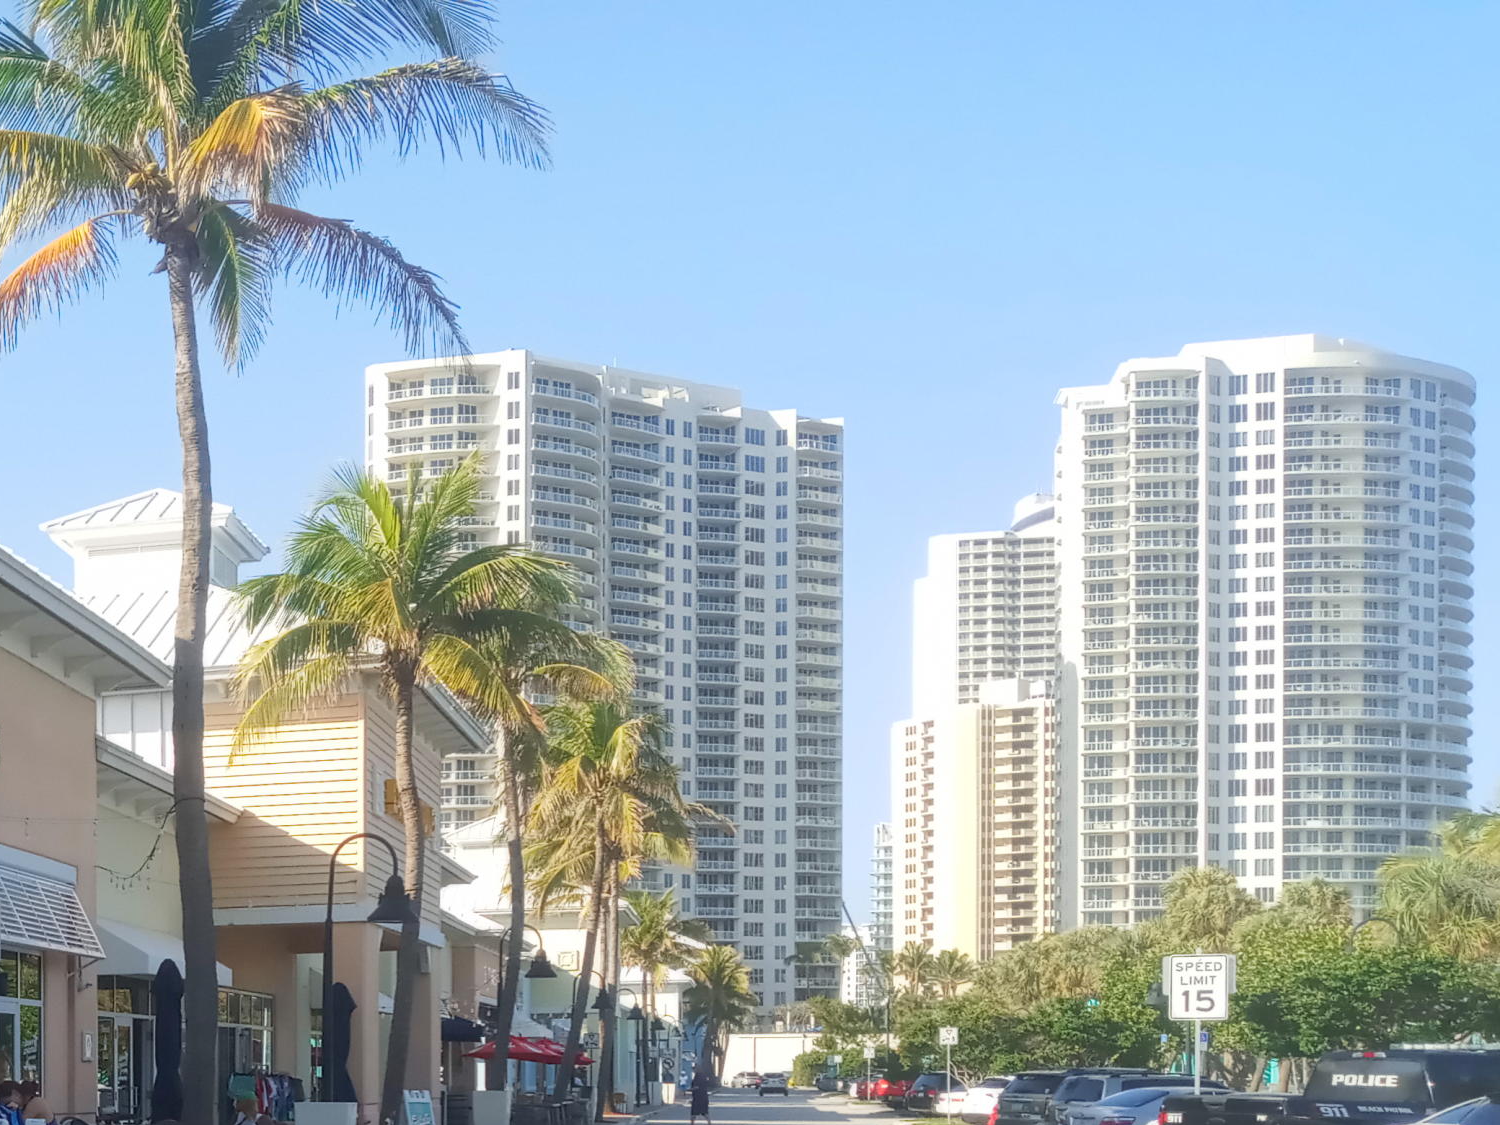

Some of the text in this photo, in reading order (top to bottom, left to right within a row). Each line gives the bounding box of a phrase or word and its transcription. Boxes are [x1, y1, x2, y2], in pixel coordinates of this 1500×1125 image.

[1175, 961, 1222, 972] SPEED
[1180, 975, 1217, 986] LIMIT
[1181, 989, 1215, 1013] 15
[1331, 1073, 1399, 1087] POLICE
[1319, 1106, 1350, 1118] 911
[1166, 1114, 1183, 1123] 911
